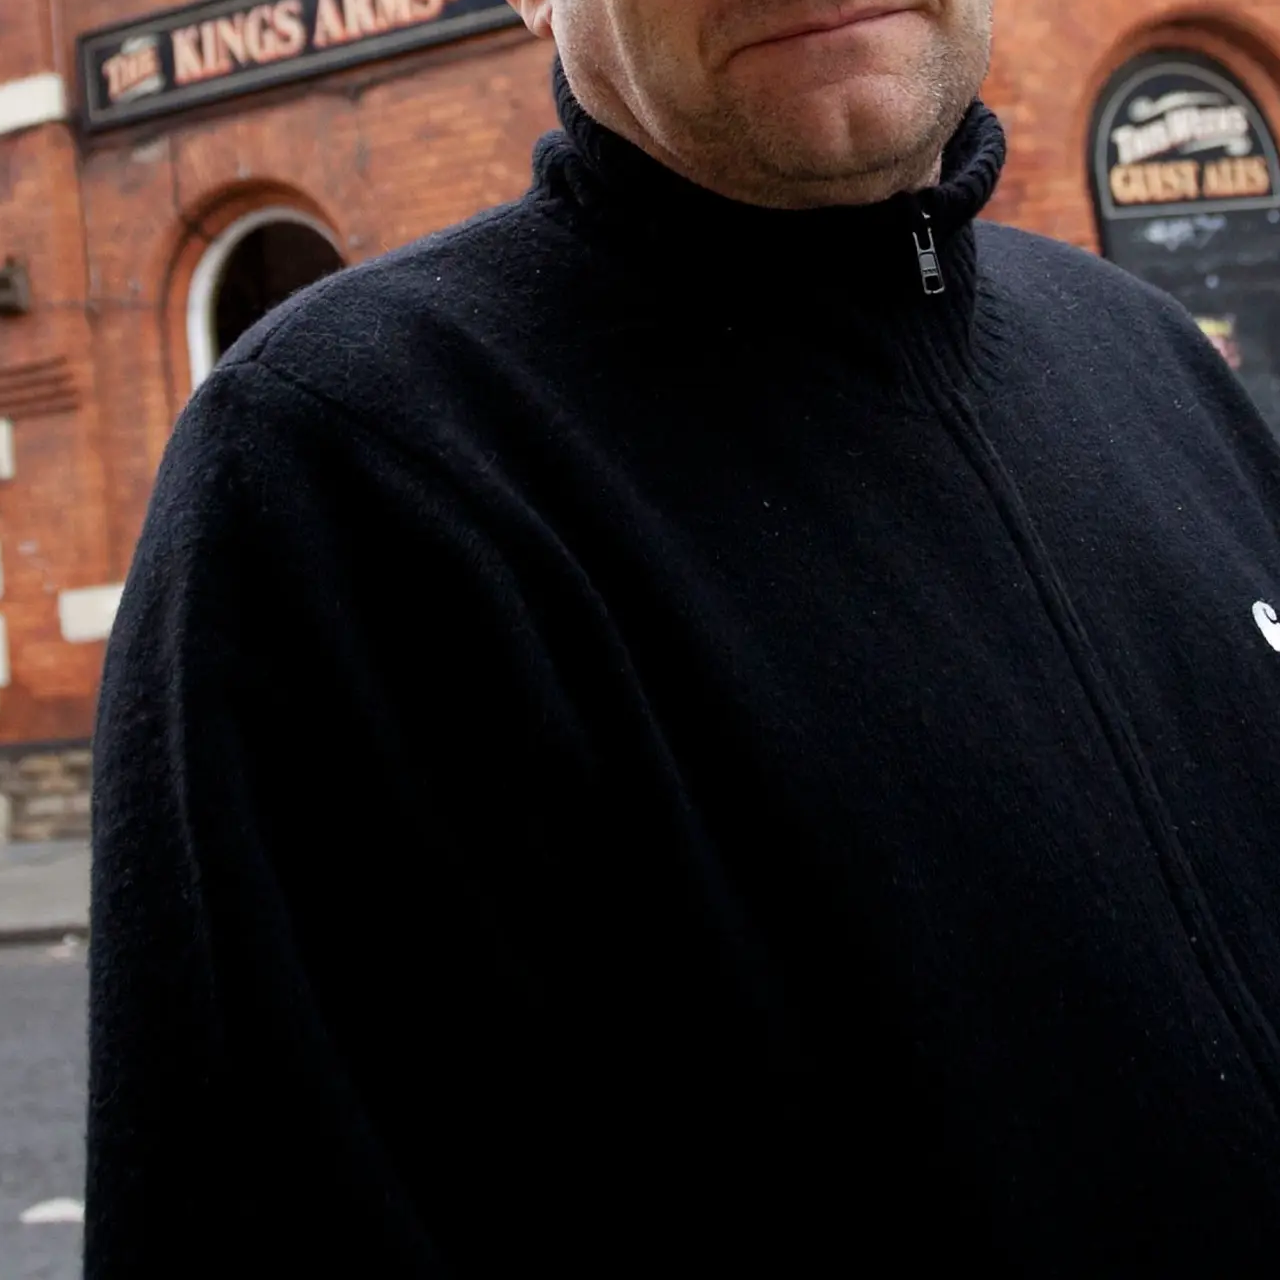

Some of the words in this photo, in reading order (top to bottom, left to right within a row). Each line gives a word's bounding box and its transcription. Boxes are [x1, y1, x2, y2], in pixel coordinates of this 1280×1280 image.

[103, 42, 162, 102] THE
[1110, 160, 1200, 206] GUEST
[1202, 156, 1270, 199] ALES
